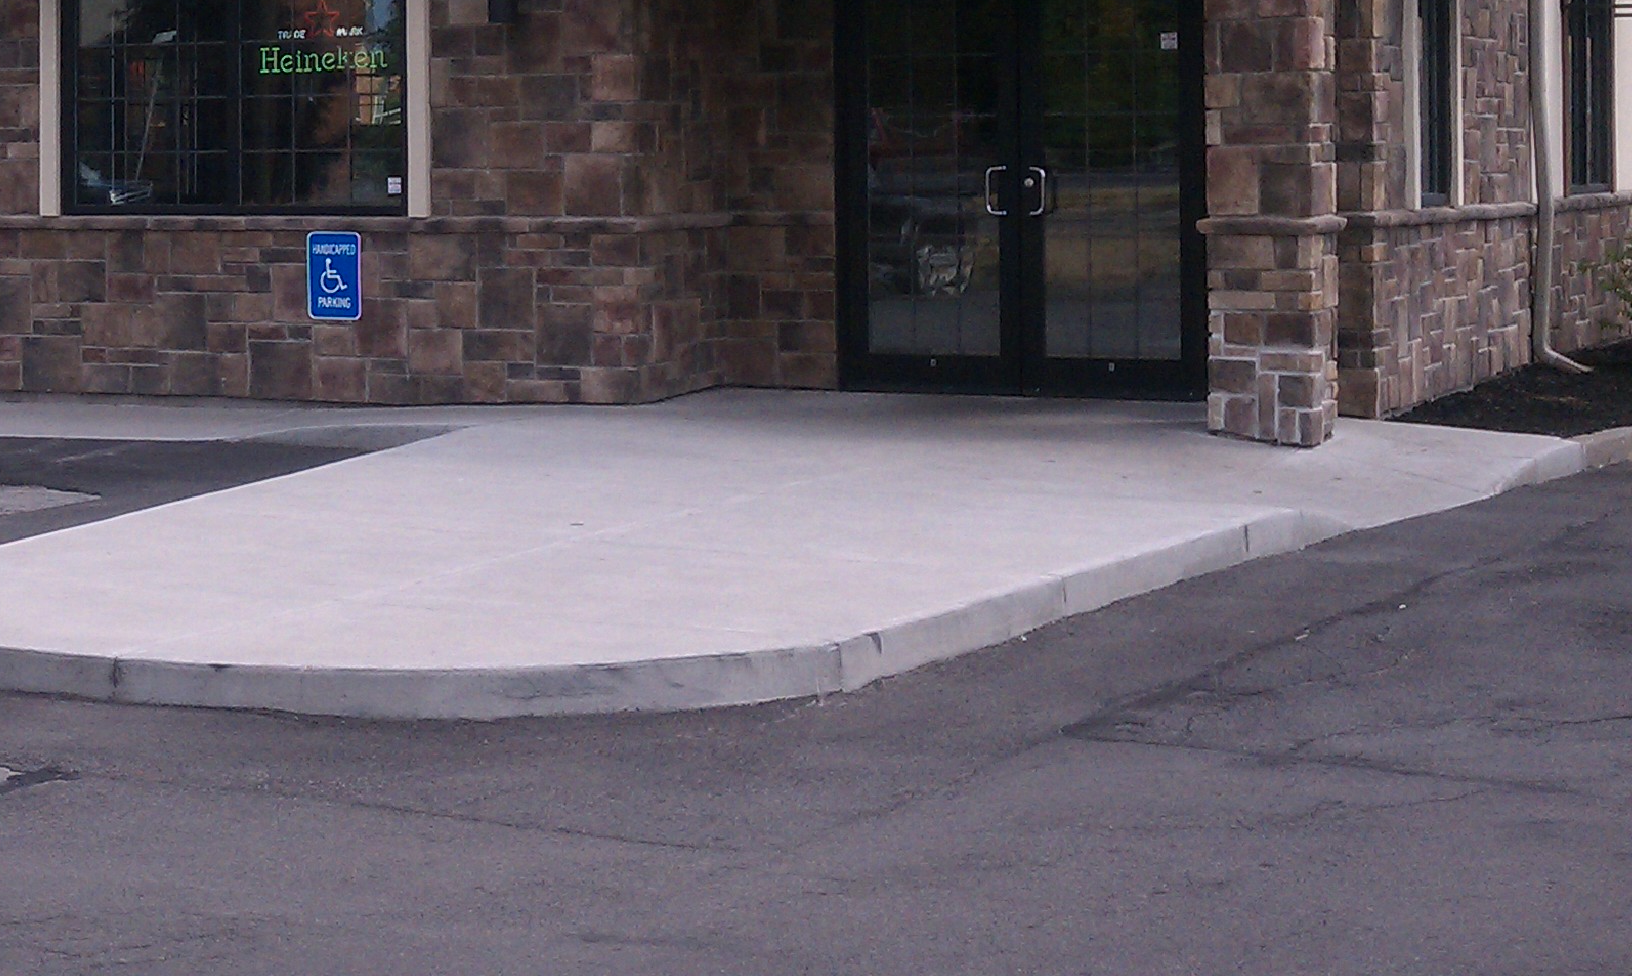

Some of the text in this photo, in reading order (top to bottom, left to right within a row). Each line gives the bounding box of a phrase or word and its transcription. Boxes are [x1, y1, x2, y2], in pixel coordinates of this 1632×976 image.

[259, 45, 388, 74] Heineken
[312, 244, 356, 255] HANDICAPPED
[317, 296, 351, 309] PARKING
